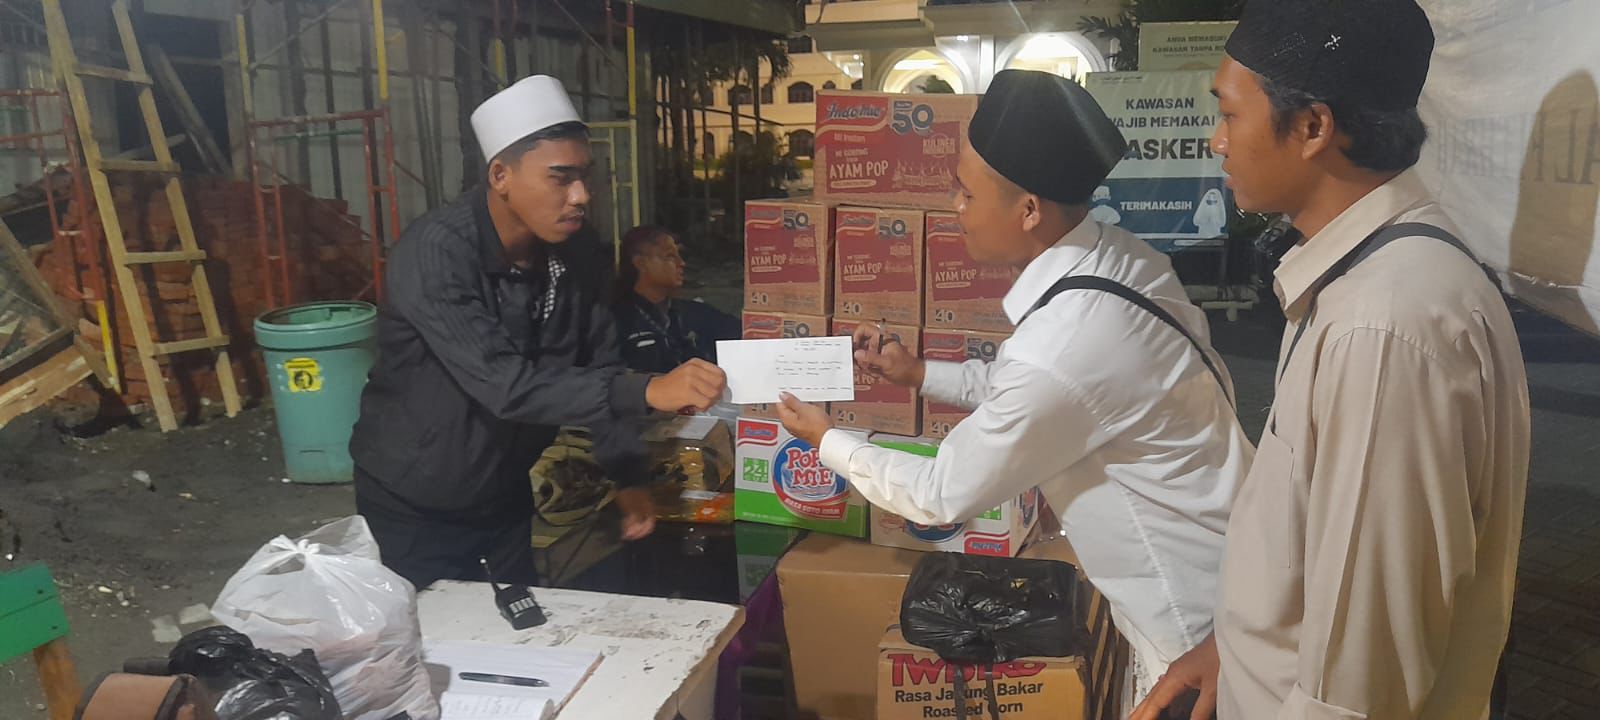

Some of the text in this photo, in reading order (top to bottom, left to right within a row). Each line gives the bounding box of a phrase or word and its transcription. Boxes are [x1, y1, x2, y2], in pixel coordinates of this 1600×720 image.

[1125, 97, 1195, 110] KAWASAN
[1150, 115, 1215, 128] MEMAKAI
[1123, 138, 1213, 160] ASKER
[830, 160, 889, 179] AYAM POP
[1120, 200, 1193, 211] TERIMAKASIH
[792, 468, 833, 486] MIE
[895, 681, 1044, 703] Rasa Jaung Bakar
[923, 703, 983, 719] Roased
